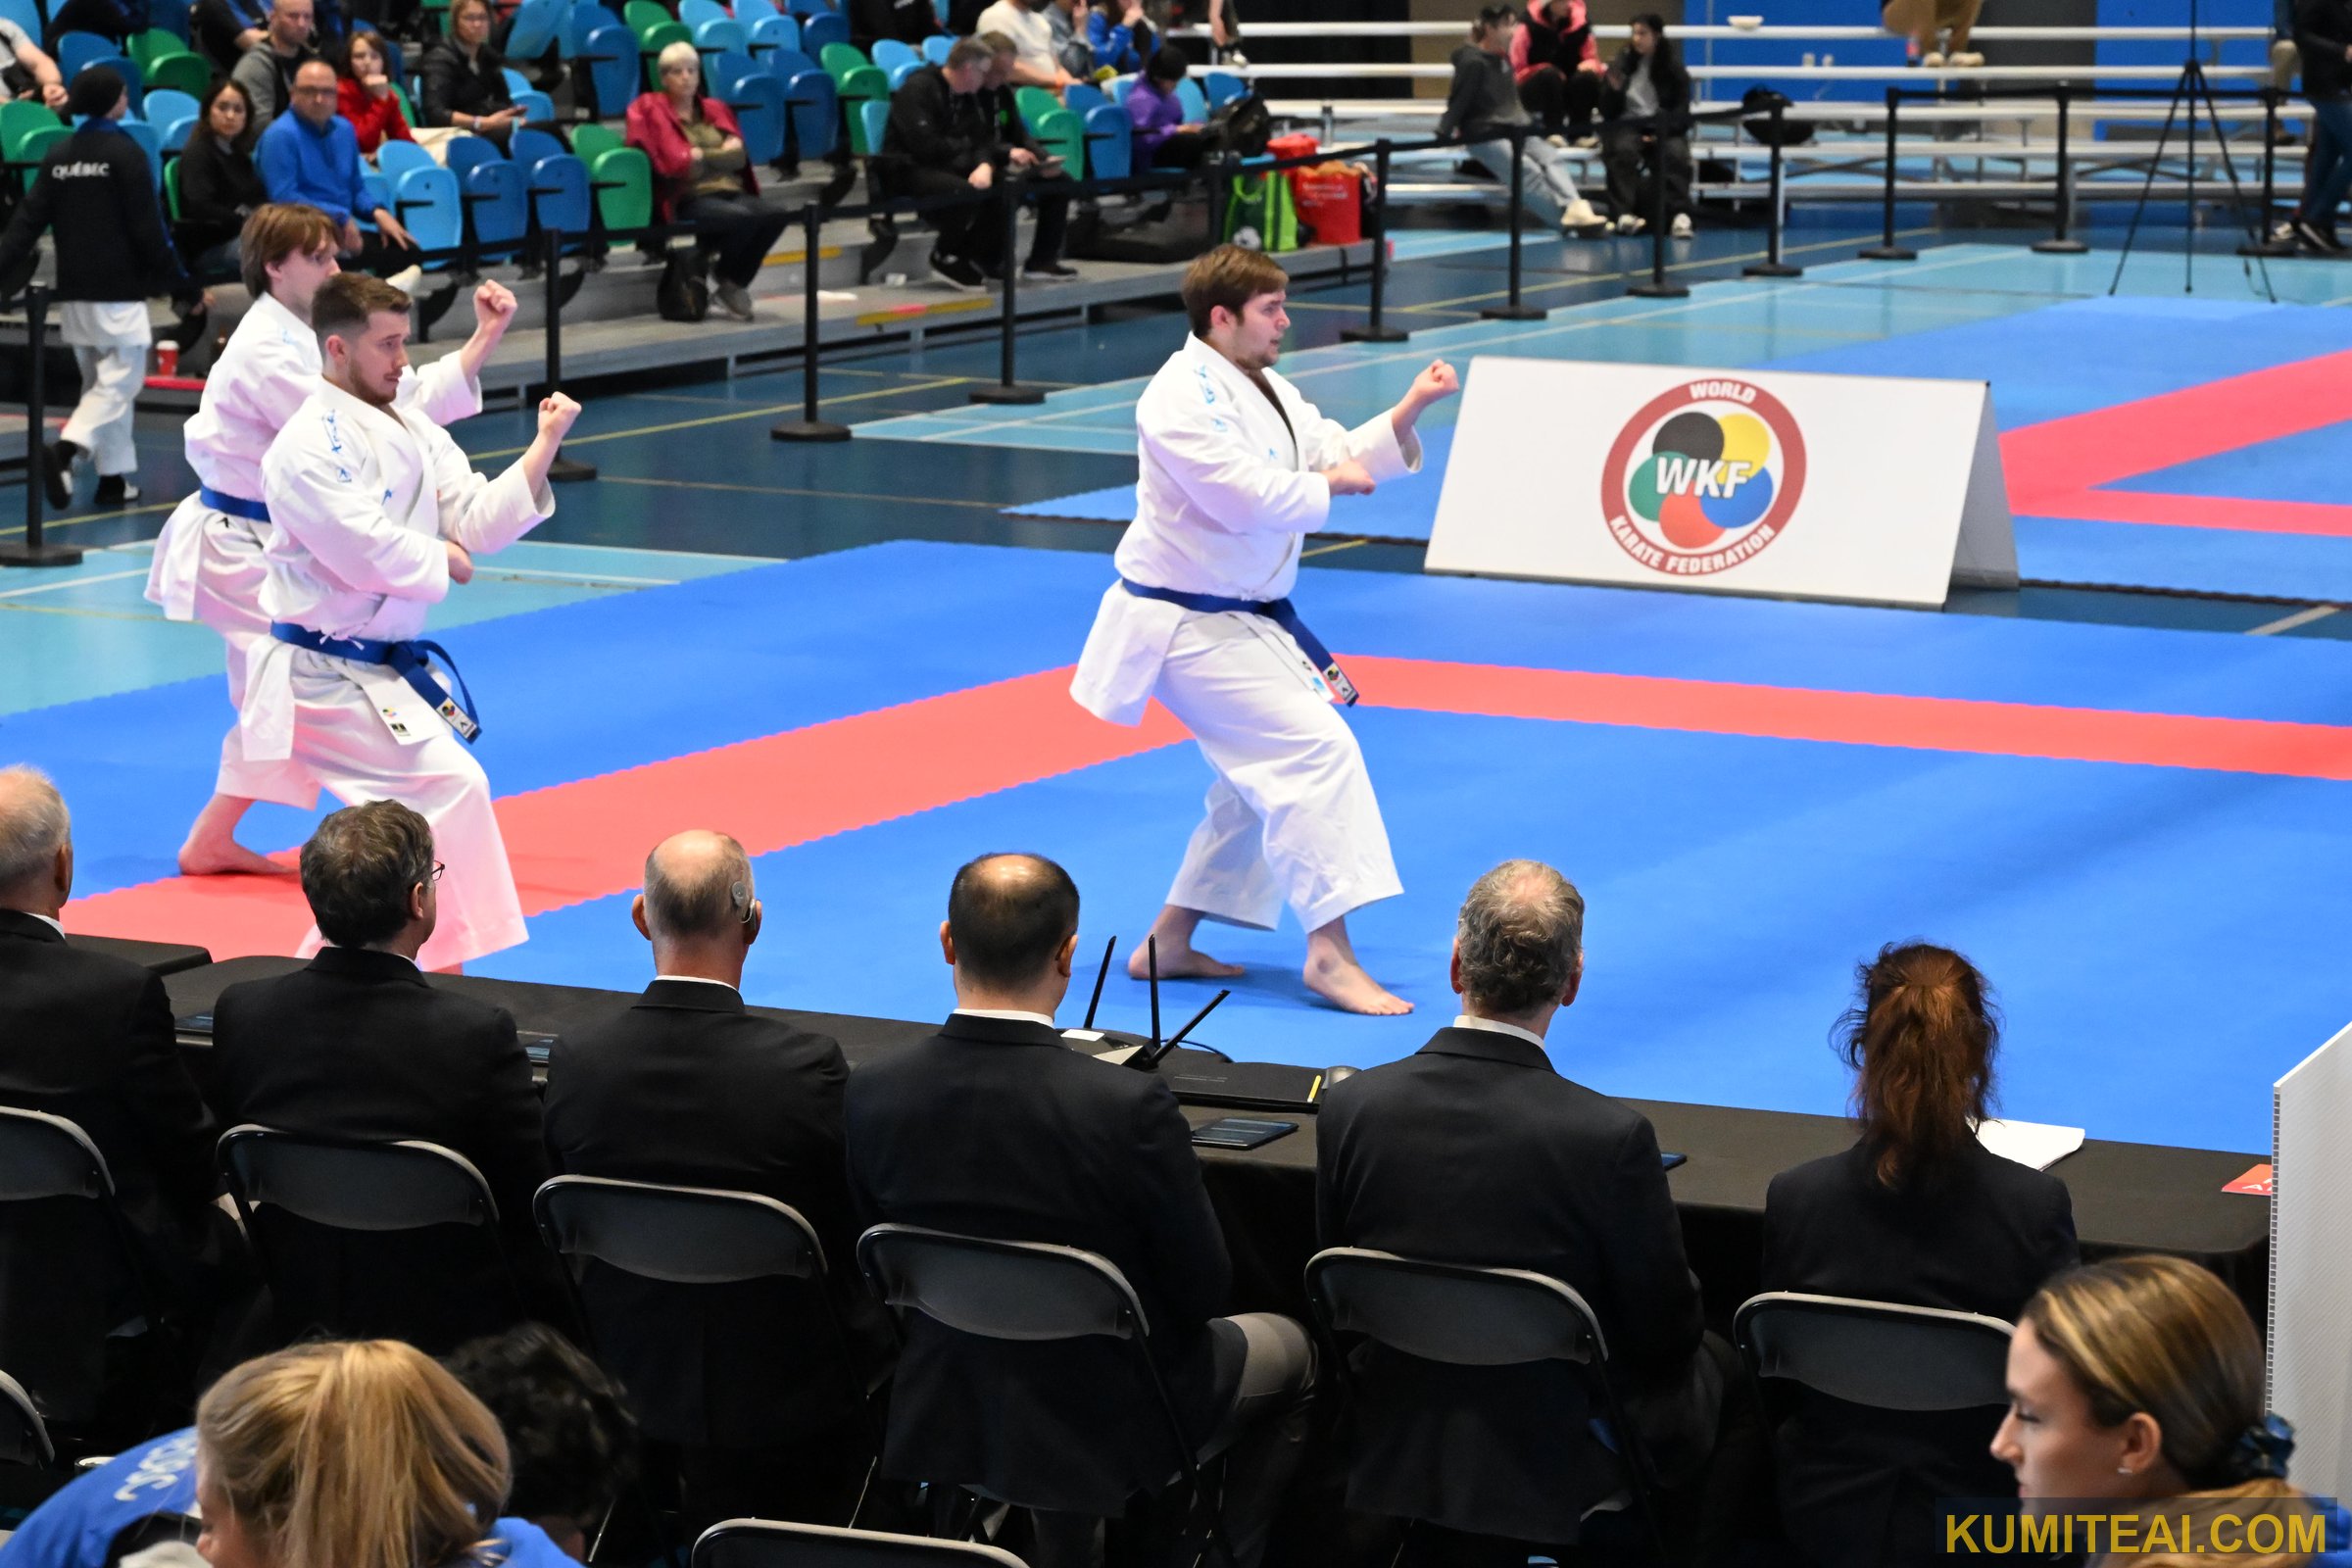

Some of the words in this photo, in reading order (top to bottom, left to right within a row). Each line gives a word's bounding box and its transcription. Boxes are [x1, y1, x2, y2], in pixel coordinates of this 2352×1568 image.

[1690, 380, 1756, 404] WORLD
[1655, 456, 1752, 499] WKF
[1609, 514, 1665, 567] KARATE
[1666, 523, 1775, 574] FEDERATION
